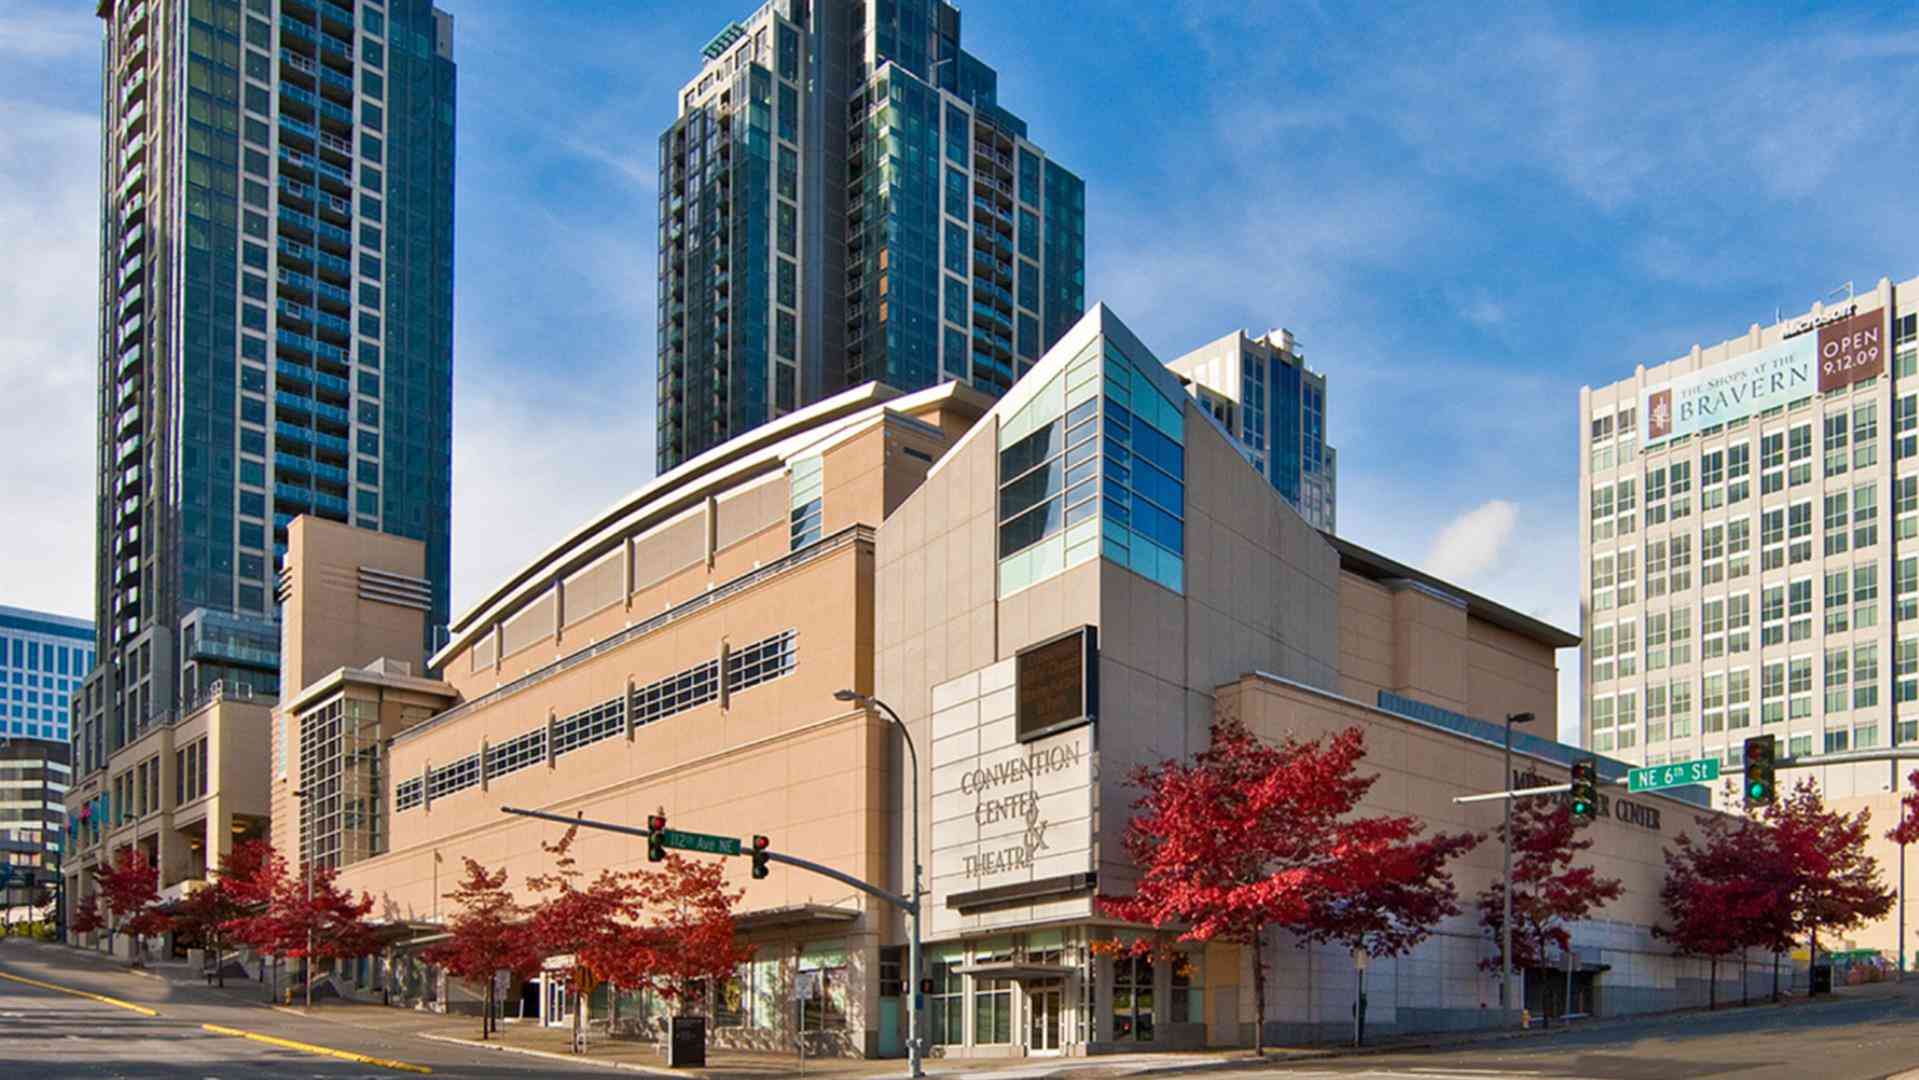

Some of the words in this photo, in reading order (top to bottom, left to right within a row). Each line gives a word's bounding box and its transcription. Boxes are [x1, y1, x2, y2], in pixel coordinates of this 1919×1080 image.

[1823, 327, 1879, 358] OPEN
[1681, 383, 1702, 399] THE
[1708, 370, 1747, 389] SHOPS
[1753, 362, 1768, 375] AT
[1772, 353, 1796, 369] THE
[1823, 347, 1879, 376] 9.12.09
[1680, 363, 1808, 421] BRAVERN
[961, 741, 1080, 796] CONVENTION
[1638, 769, 1657, 788] NE
[1664, 767, 1684, 784] 6th
[1691, 763, 1708, 780] St
[975, 790, 1039, 827] CENTER
[1616, 798, 1660, 830] CENTER
[696, 837, 716, 852] Ave
[720, 839, 734, 854] NE
